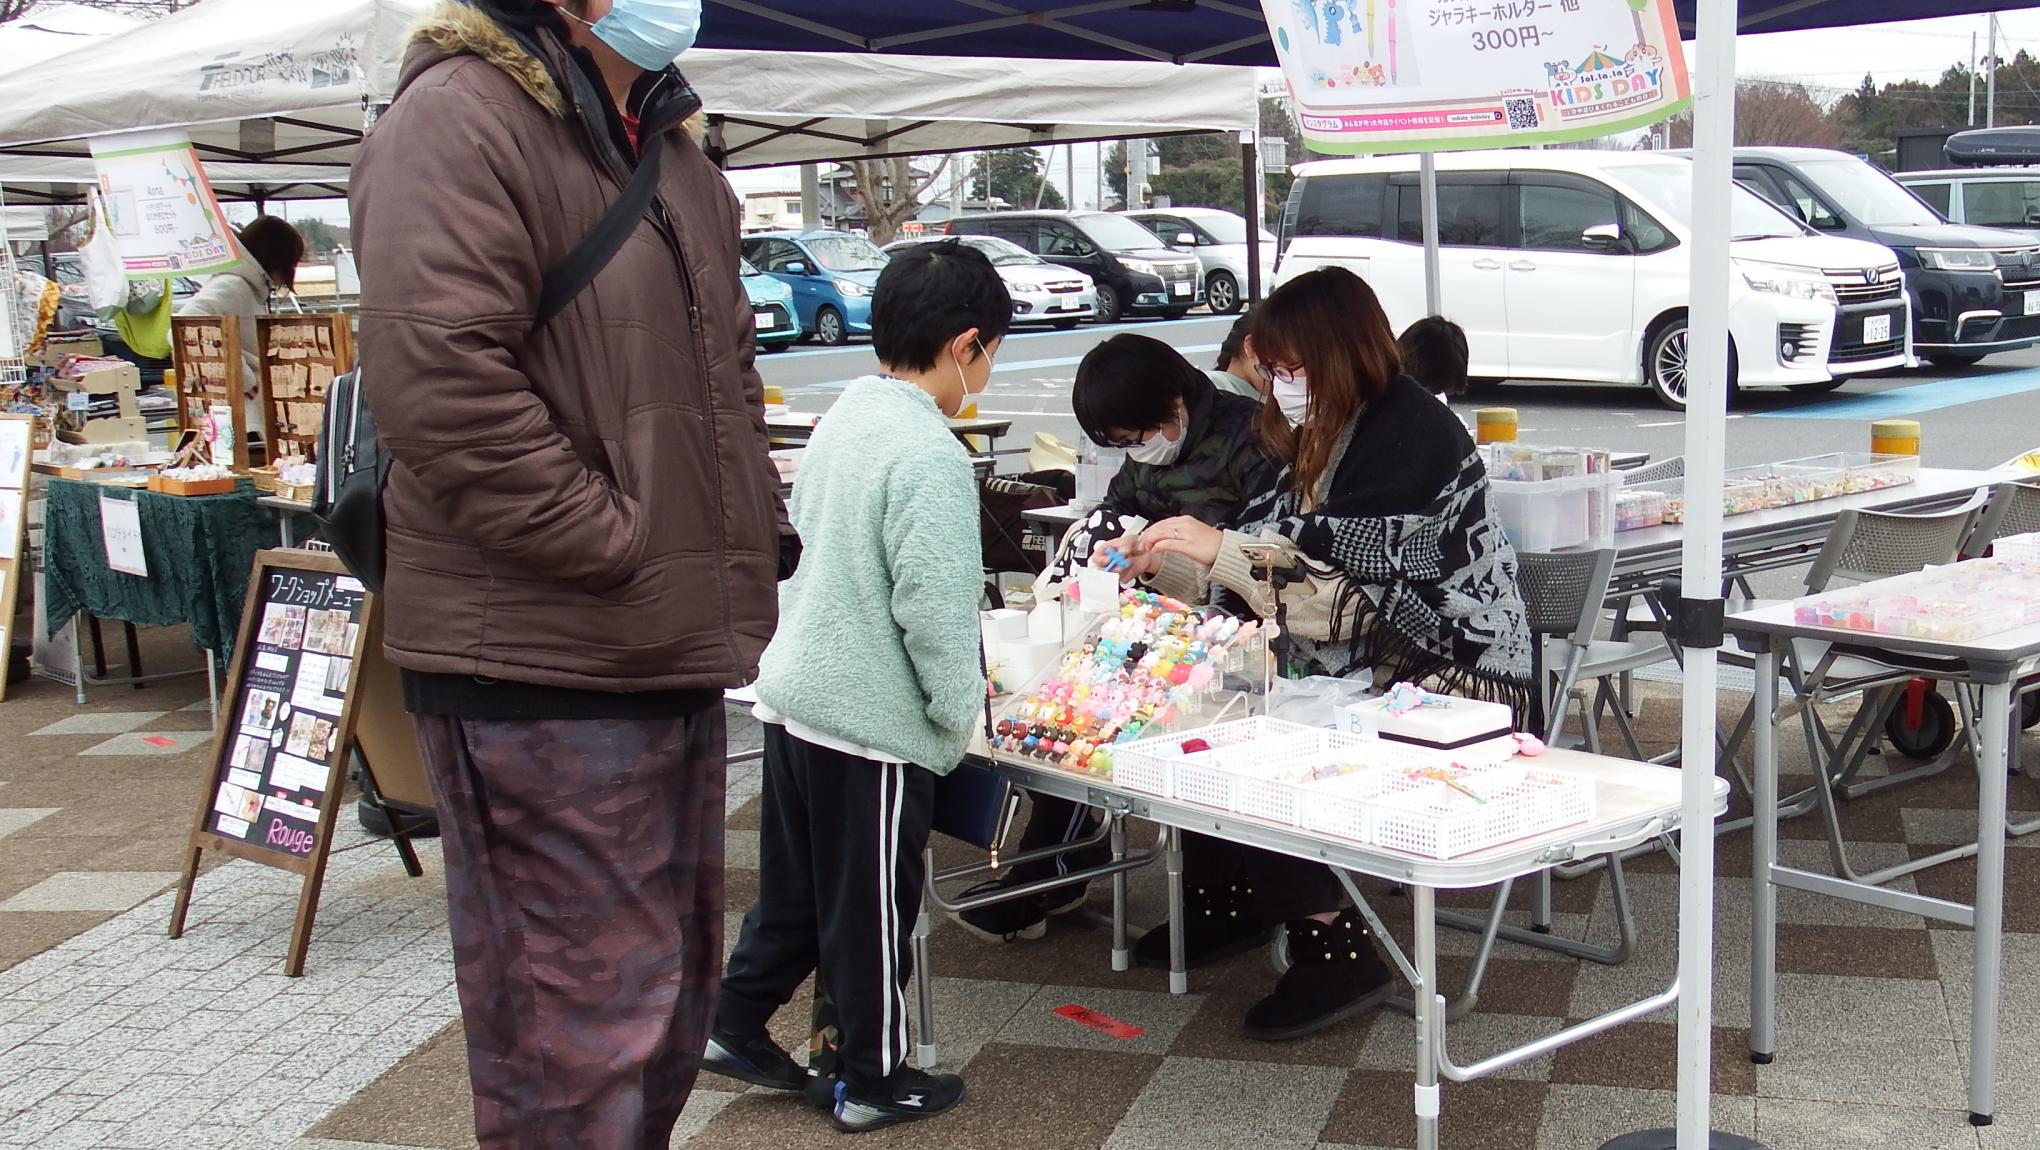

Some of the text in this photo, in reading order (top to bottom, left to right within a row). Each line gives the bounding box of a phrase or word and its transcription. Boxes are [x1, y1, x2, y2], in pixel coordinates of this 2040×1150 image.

[1549, 68, 1659, 106] KIDS DAY
[270, 574, 364, 607] ワークショップメニュー
[1350, 713, 1363, 735] B
[265, 817, 314, 853] Rouge
